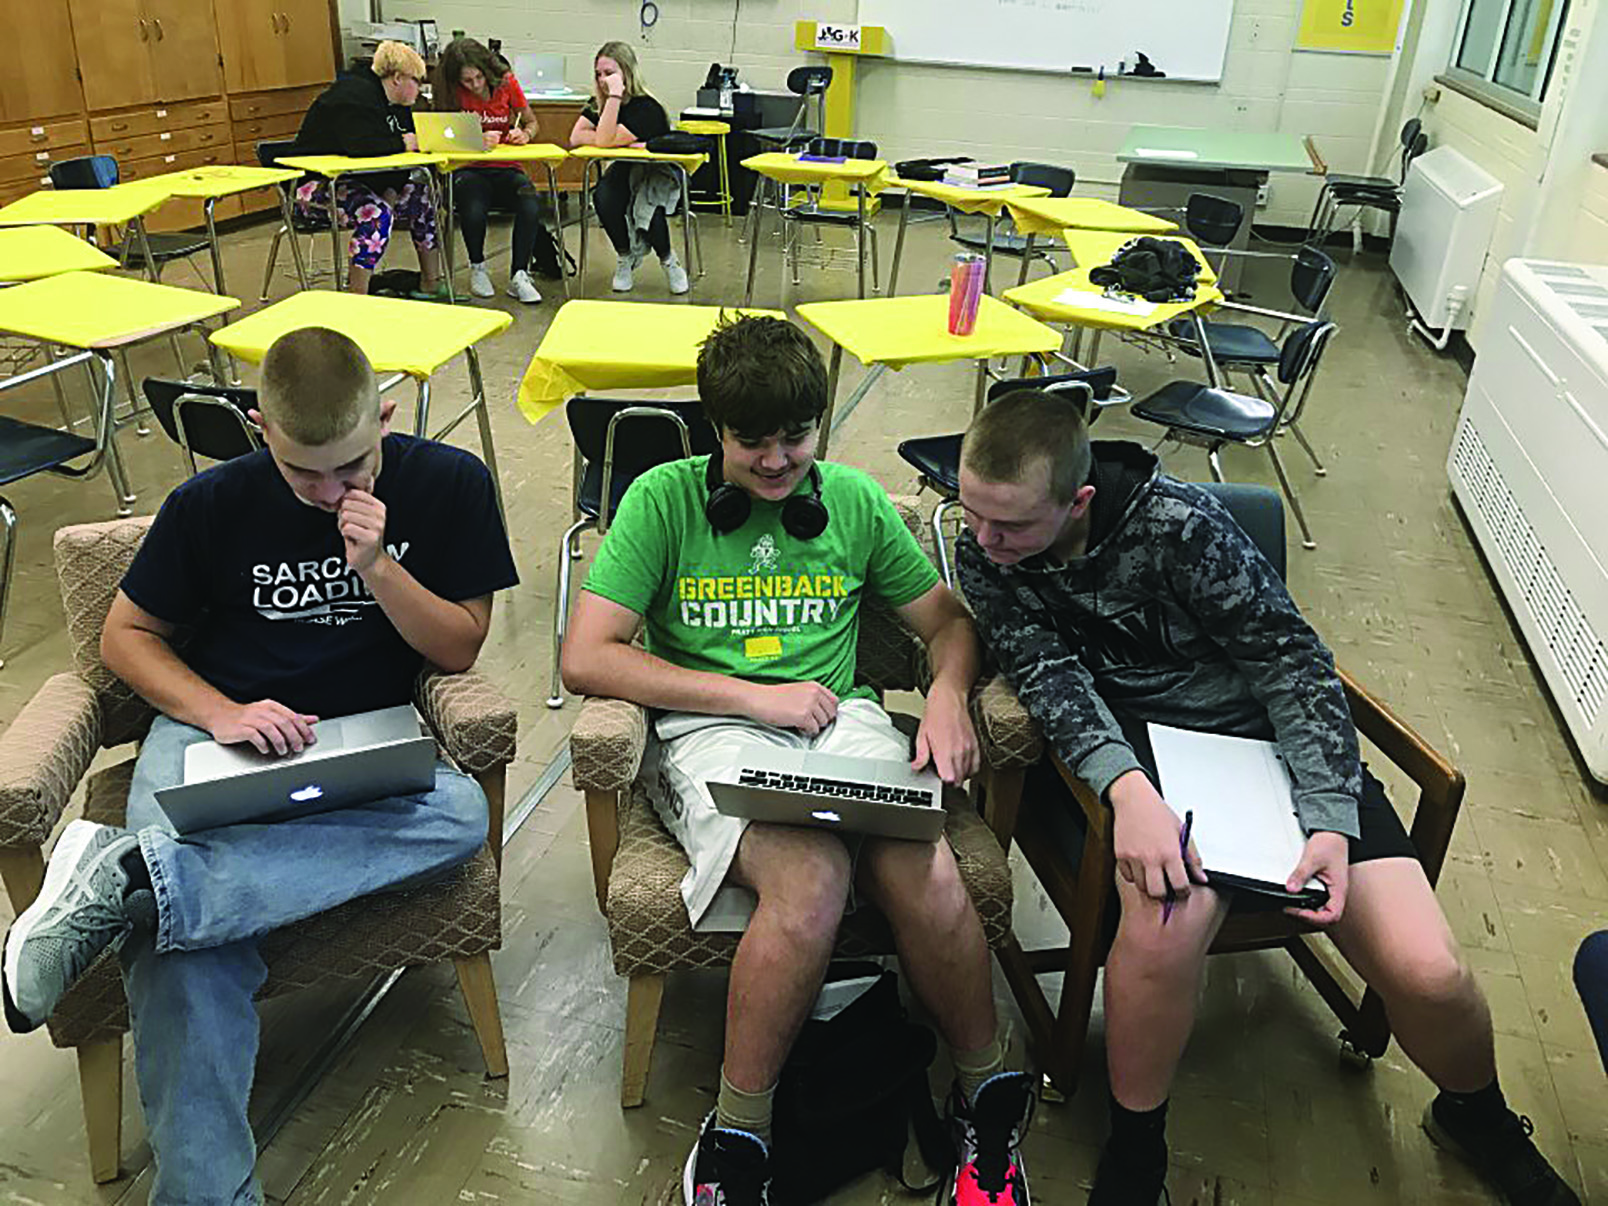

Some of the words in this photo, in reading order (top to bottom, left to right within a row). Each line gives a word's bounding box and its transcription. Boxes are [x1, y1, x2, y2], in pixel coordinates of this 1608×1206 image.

[252, 575, 377, 608] LOADI
[678, 575, 848, 600] GREENBACK
[680, 598, 847, 628] COUNTRY
